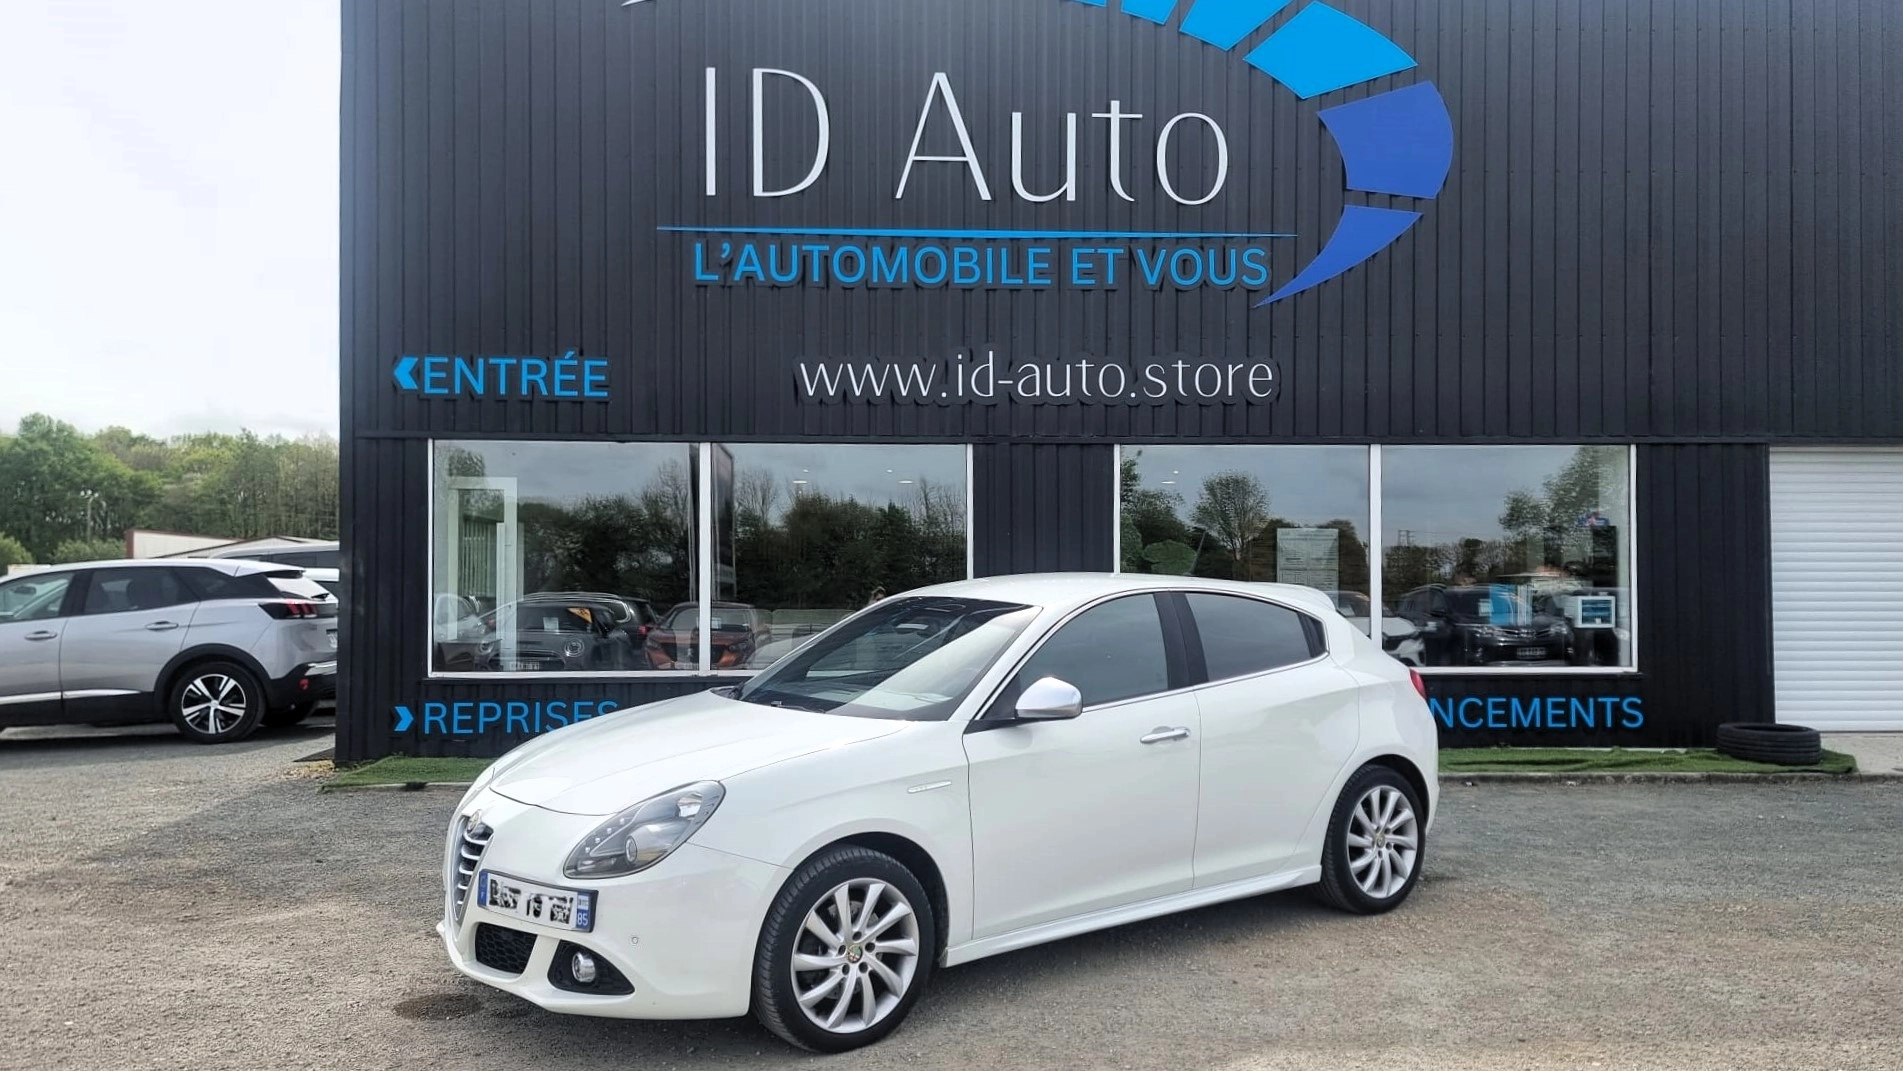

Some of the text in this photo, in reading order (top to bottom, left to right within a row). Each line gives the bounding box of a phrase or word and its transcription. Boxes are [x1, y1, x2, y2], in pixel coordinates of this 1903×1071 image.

[705, 66, 1228, 205] ID Auto
[694, 242, 1268, 286] L'AUTOMOBILE ET VOUS
[422, 350, 609, 398] ENTRÉE
[800, 350, 1273, 399] www.id-auto.store
[577, 912, 589, 926] 85
